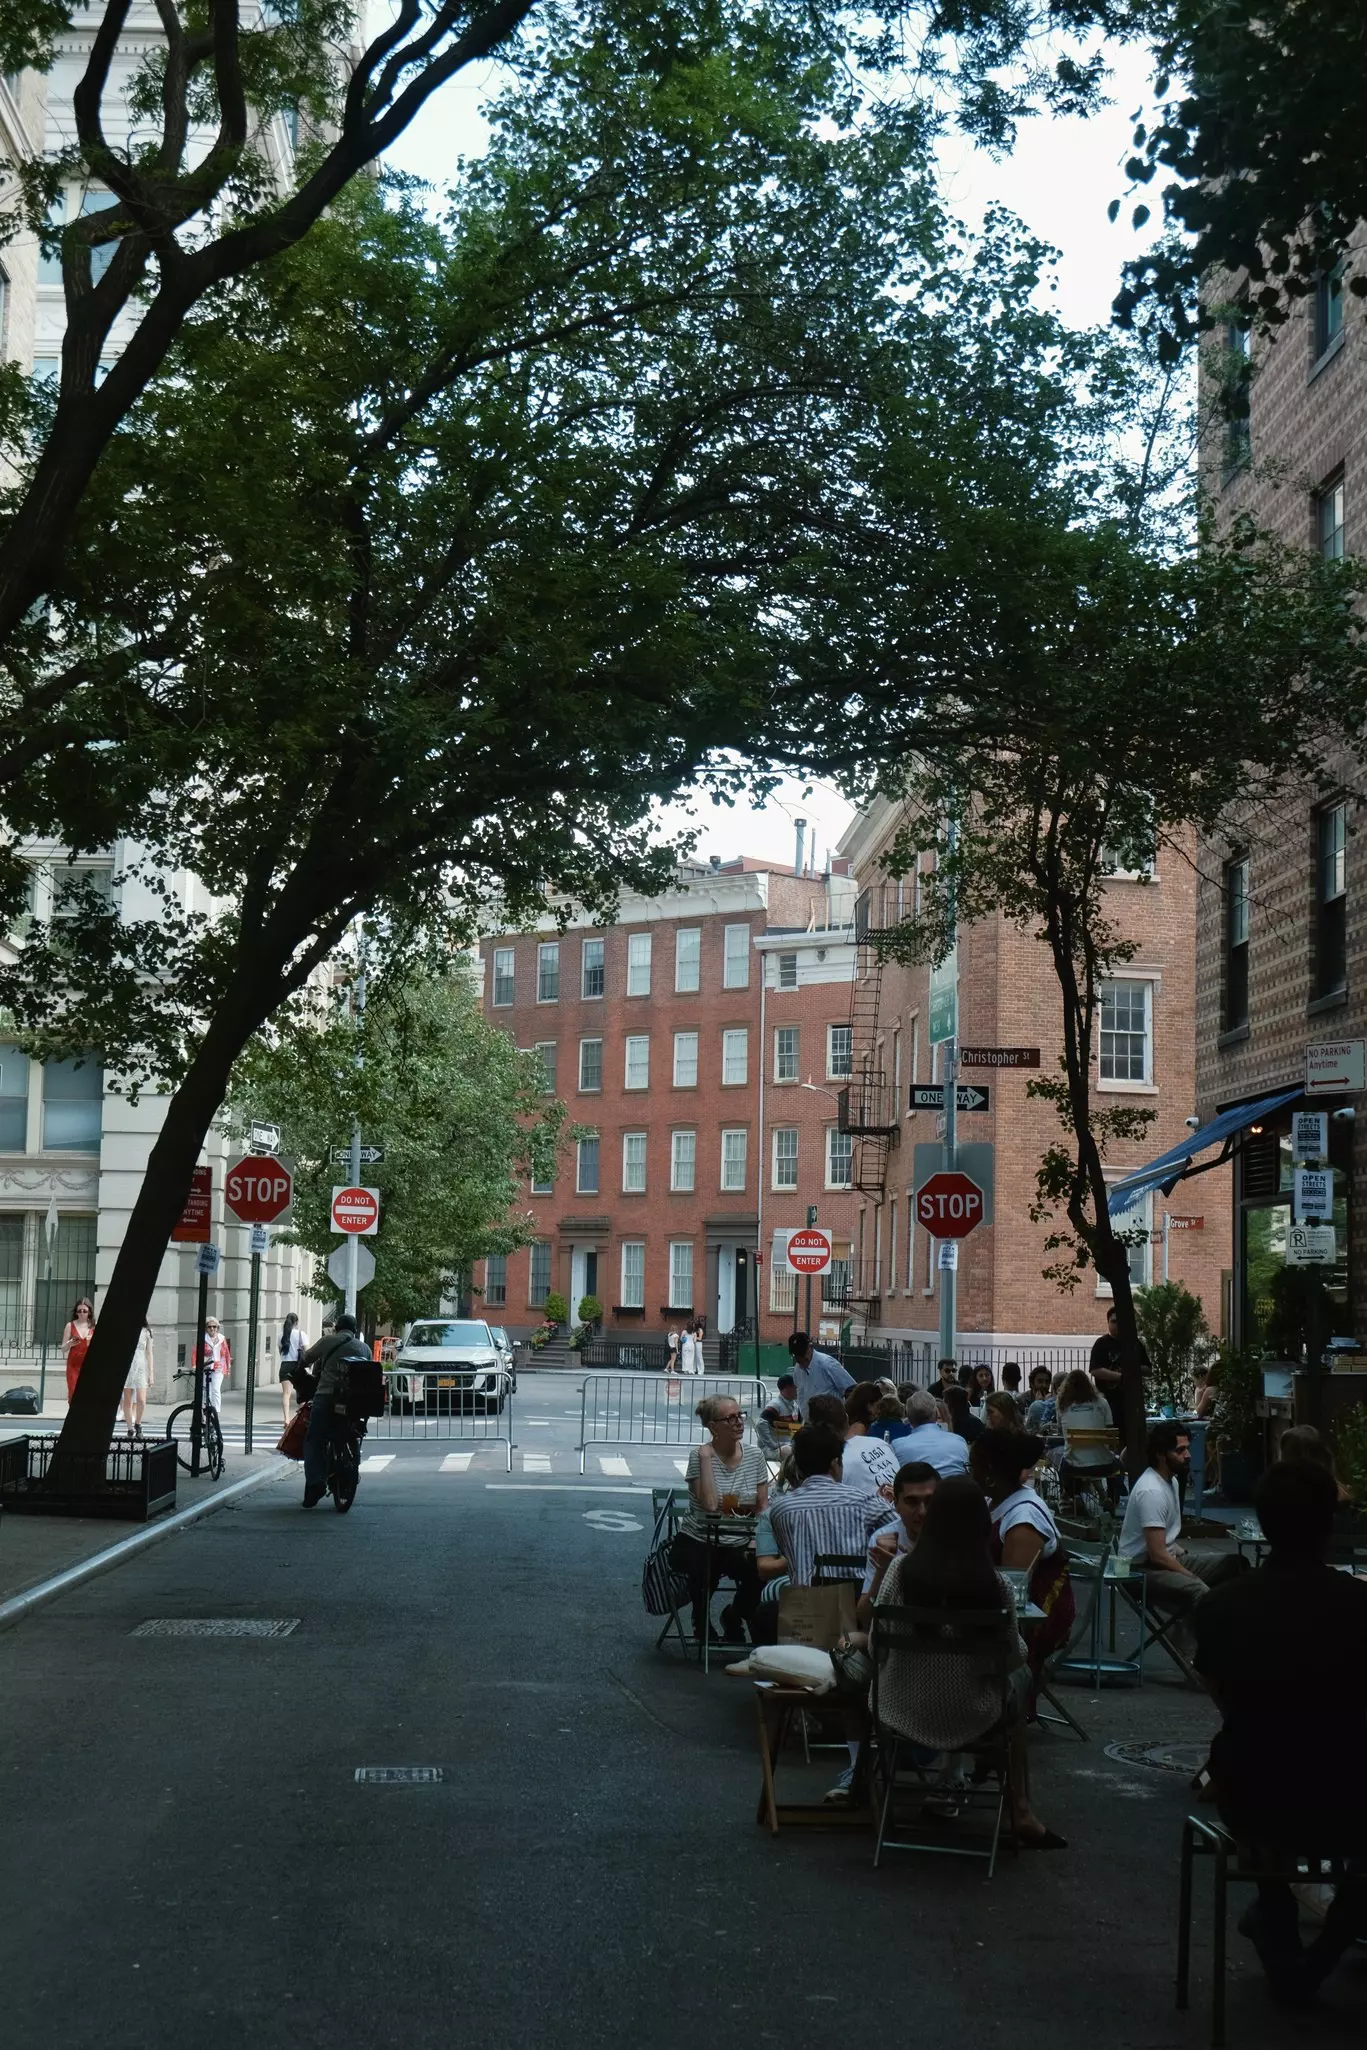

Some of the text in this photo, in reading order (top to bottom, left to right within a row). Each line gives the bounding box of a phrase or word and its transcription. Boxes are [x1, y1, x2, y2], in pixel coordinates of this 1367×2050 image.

[1309, 1045, 1351, 1058] NO PARKING
[962, 1050, 1030, 1066] Christopher St
[1309, 1060, 1338, 1070] Anytime
[920, 1092, 943, 1103] ONE
[360, 1150, 377, 1158] WAY
[228, 1176, 288, 1203] STOP
[187, 1199, 208, 1207] TANDING
[341, 1196, 370, 1205] DO NOT
[921, 1194, 980, 1219] STOP
[183, 1209, 204, 1217] NYTIME
[341, 1216, 367, 1225] ENTER
[1171, 1218, 1189, 1228] Grove
[795, 1238, 823, 1246] DO NOT
[796, 1257, 821, 1265] ENTER
